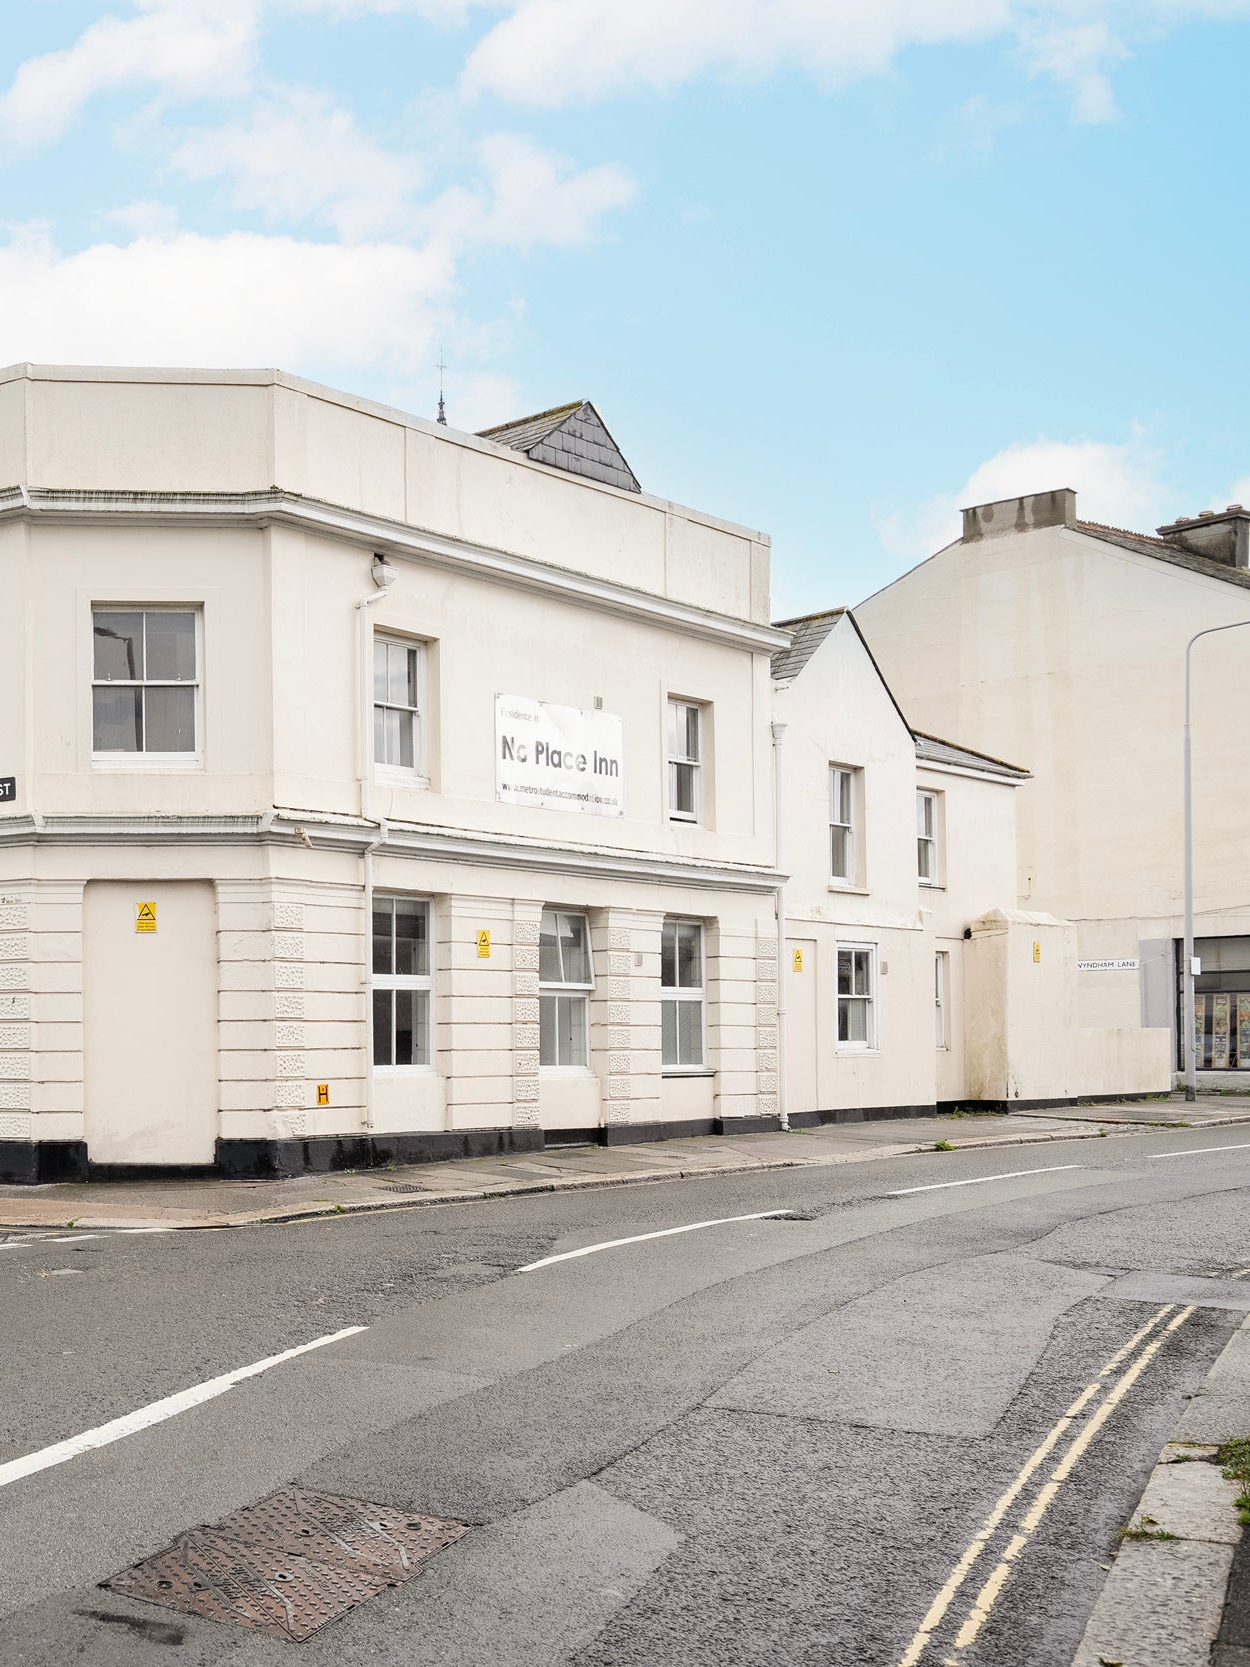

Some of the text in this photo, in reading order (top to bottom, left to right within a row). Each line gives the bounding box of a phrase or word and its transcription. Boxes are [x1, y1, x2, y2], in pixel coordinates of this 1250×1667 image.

[501, 706, 532, 722] Rsidence
[502, 735, 619, 777] No Place Inn
[318, 1086, 329, 1102] H
